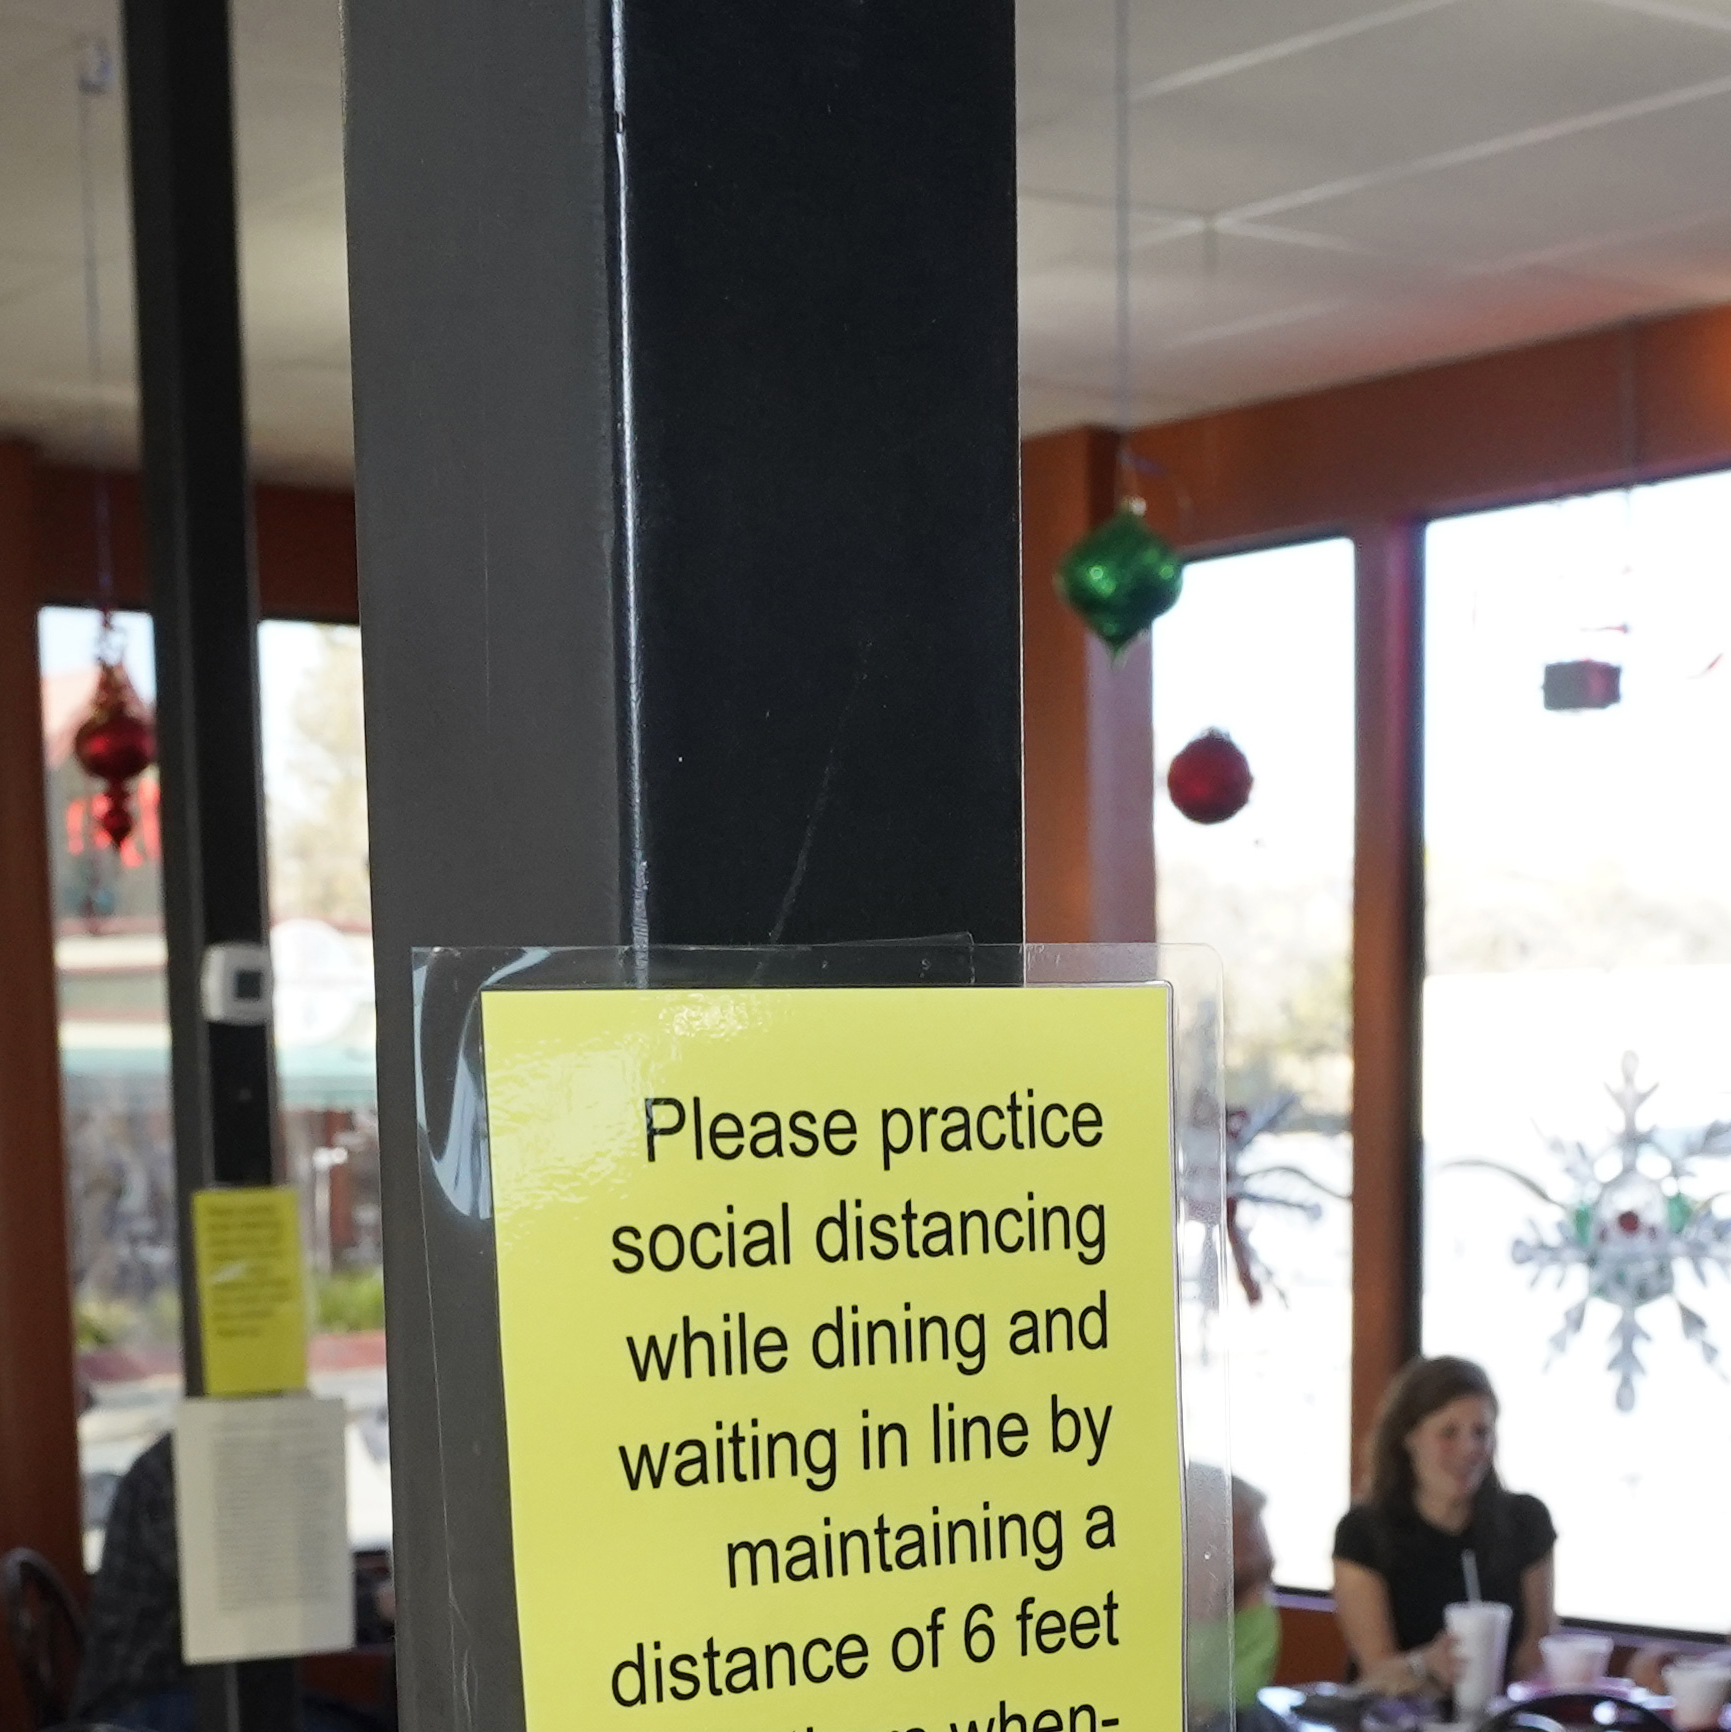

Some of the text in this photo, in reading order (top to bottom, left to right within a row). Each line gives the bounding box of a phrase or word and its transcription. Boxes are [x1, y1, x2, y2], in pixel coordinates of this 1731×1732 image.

[644, 1088, 1103, 1171] Please practice
[612, 1192, 1106, 1274] social distancing
[625, 1290, 1108, 1383] while dining and
[618, 1393, 1113, 1492] waiting in line by
[727, 1501, 1116, 1588] maintaining a
[611, 1590, 1120, 1708] distance of 6 feet
